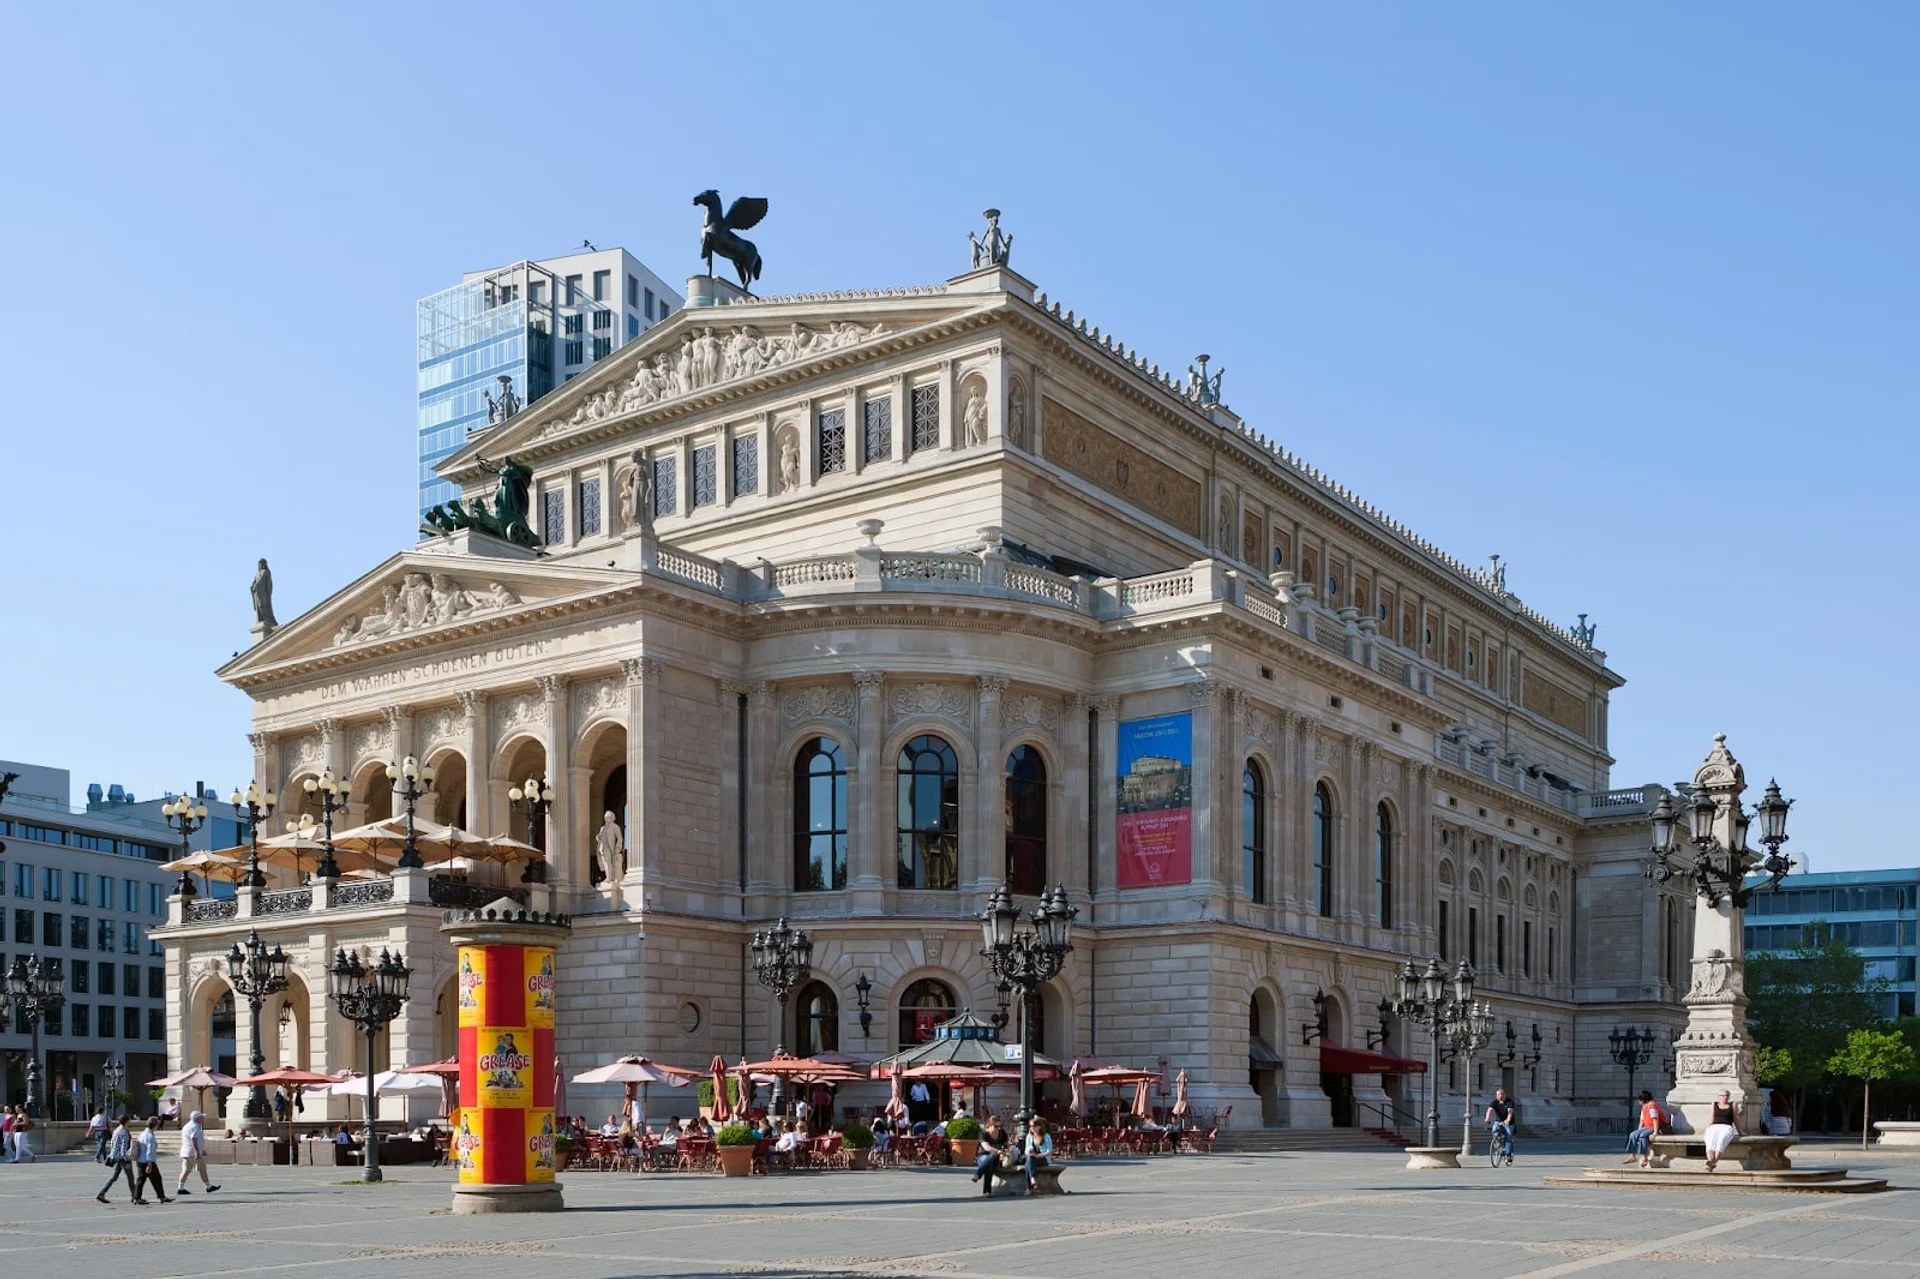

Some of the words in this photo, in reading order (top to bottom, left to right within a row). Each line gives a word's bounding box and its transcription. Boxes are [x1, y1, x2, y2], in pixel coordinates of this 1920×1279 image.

[321, 680, 347, 700] DEM
[353, 669, 406, 693] WAHREN
[413, 652, 488, 680] SCHOENEN
[480, 1053, 531, 1072] GREASE
